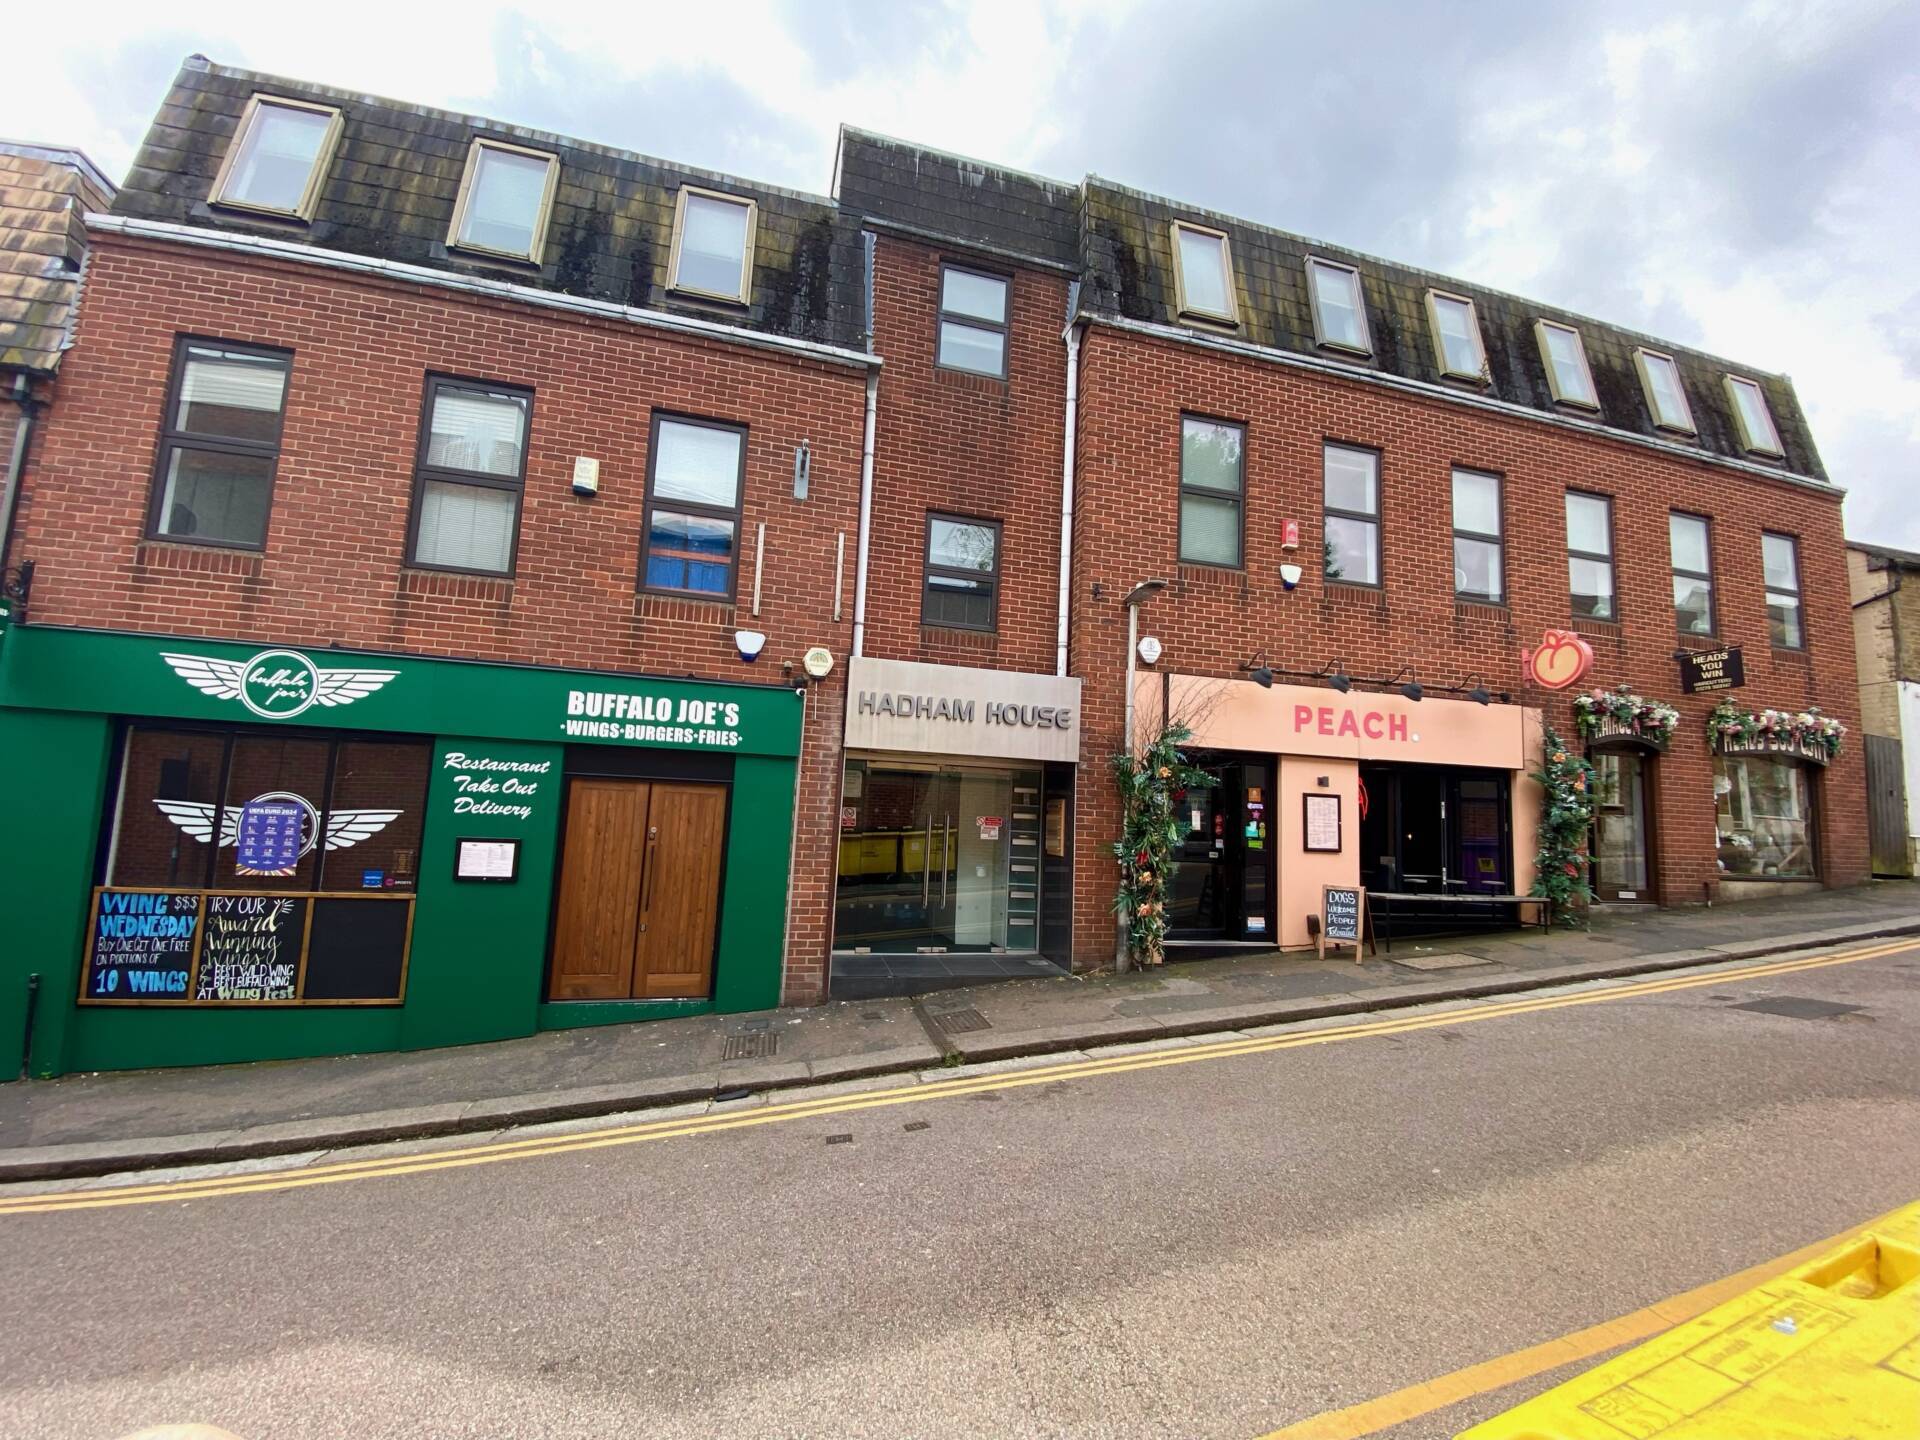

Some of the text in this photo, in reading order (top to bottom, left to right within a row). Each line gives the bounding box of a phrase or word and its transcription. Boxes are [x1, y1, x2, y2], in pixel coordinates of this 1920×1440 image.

[1692, 652, 1729, 664] HEADS
[1700, 661, 1723, 671] YOU
[1701, 669, 1723, 679] WIN
[567, 691, 740, 727] BUFFALO JOE'S
[858, 691, 1072, 730] HADHAM HOUSE
[566, 720, 739, 747] WINGS BURGERS FRIES
[443, 752, 551, 774] Restaurant
[453, 774, 538, 795] Take Out
[453, 796, 532, 820] Delivery
[102, 893, 168, 914] WING
[208, 897, 267, 914] TRY OUR
[1329, 890, 1356, 904] DOGS
[100, 915, 199, 937] WEDNESDAY
[208, 900, 284, 933] Award
[1327, 914, 1356, 925] PEOPLE
[97, 937, 116, 952] BUY
[116, 938, 134, 952] ONE
[151, 938, 169, 952] ONE
[169, 938, 190, 952] FREE
[206, 932, 282, 965] Winning
[96, 952, 162, 966] ON PORTIONS OF
[96, 969, 189, 993] 10 WINGS
[214, 964, 239, 979] BEST
[239, 964, 268, 978] WILD
[269, 964, 295, 977] WING
[213, 976, 236, 989] BEST
[236, 975, 271, 988] BUFFALO
[196, 988, 215, 1001] AT
[217, 986, 261, 1001] Wing
